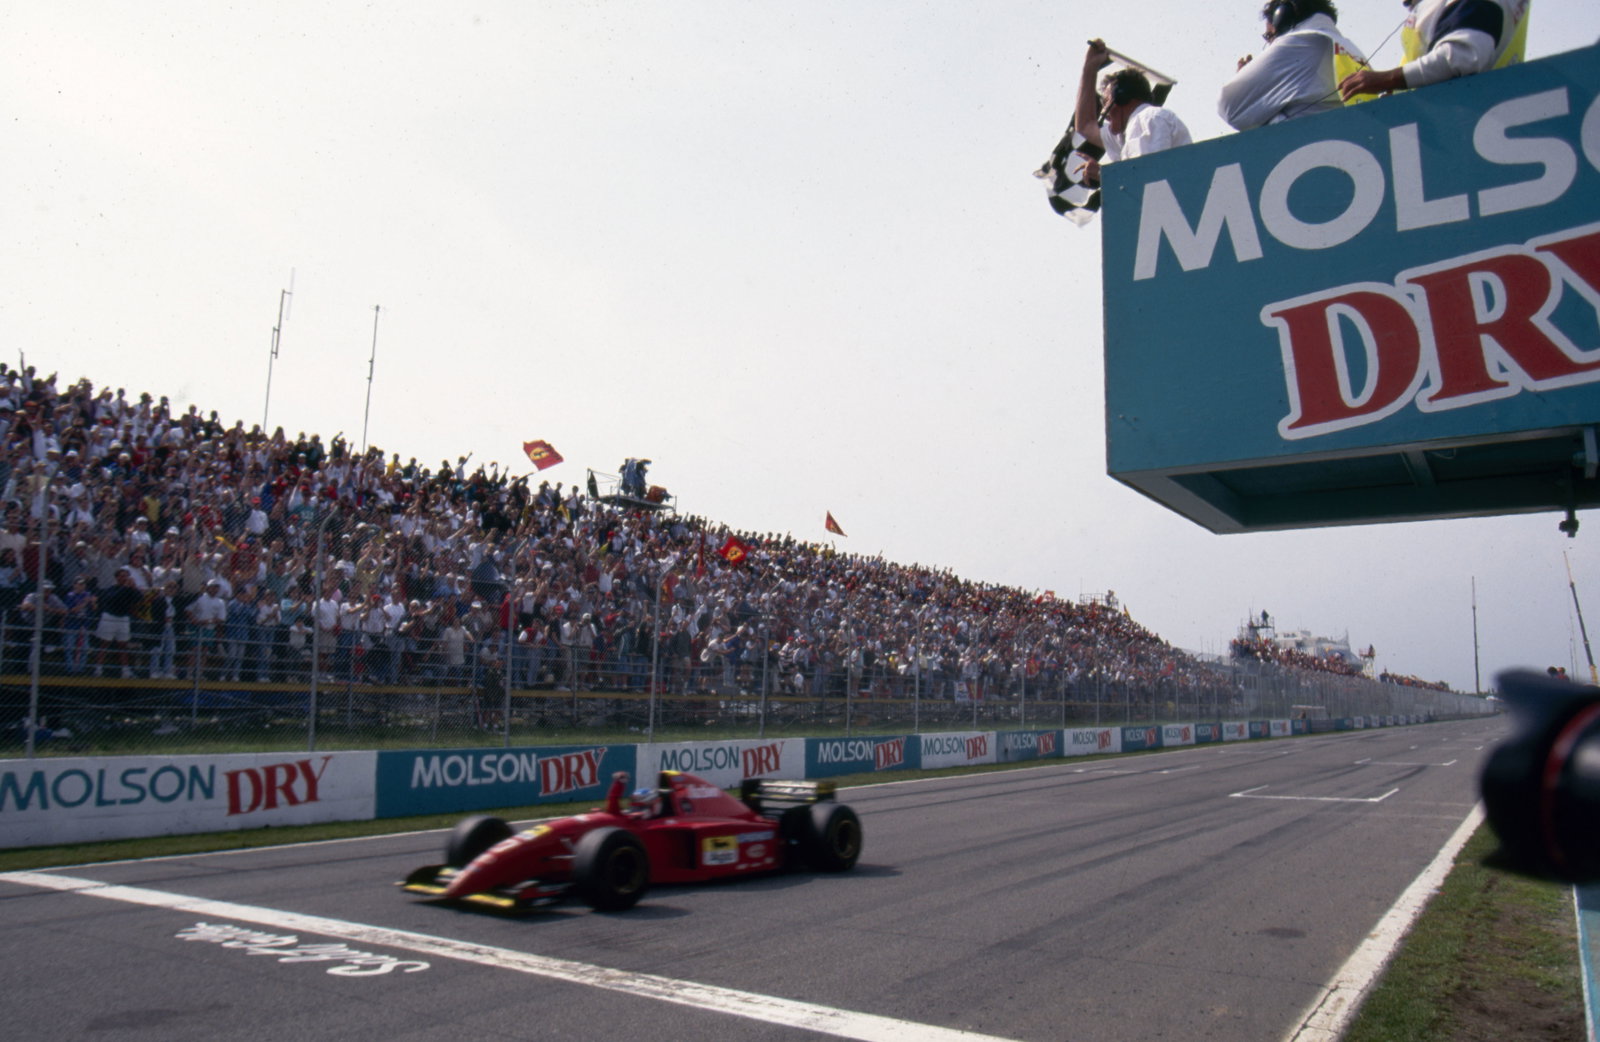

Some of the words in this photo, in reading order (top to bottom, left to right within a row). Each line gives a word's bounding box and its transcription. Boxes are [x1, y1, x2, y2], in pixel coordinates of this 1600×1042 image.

[1133, 86, 1600, 281] MOLS
[660, 745, 740, 772] MOLSON
[742, 741, 786, 778] DRY
[818, 740, 875, 763] MOLSON
[873, 736, 908, 771] DRY
[924, 736, 966, 755] MOLSON
[965, 731, 995, 760] DRY
[0, 764, 217, 812] MOLSON
[223, 755, 334, 817] DRY
[411, 753, 538, 789] MOLSON
[537, 747, 608, 797] DRY
